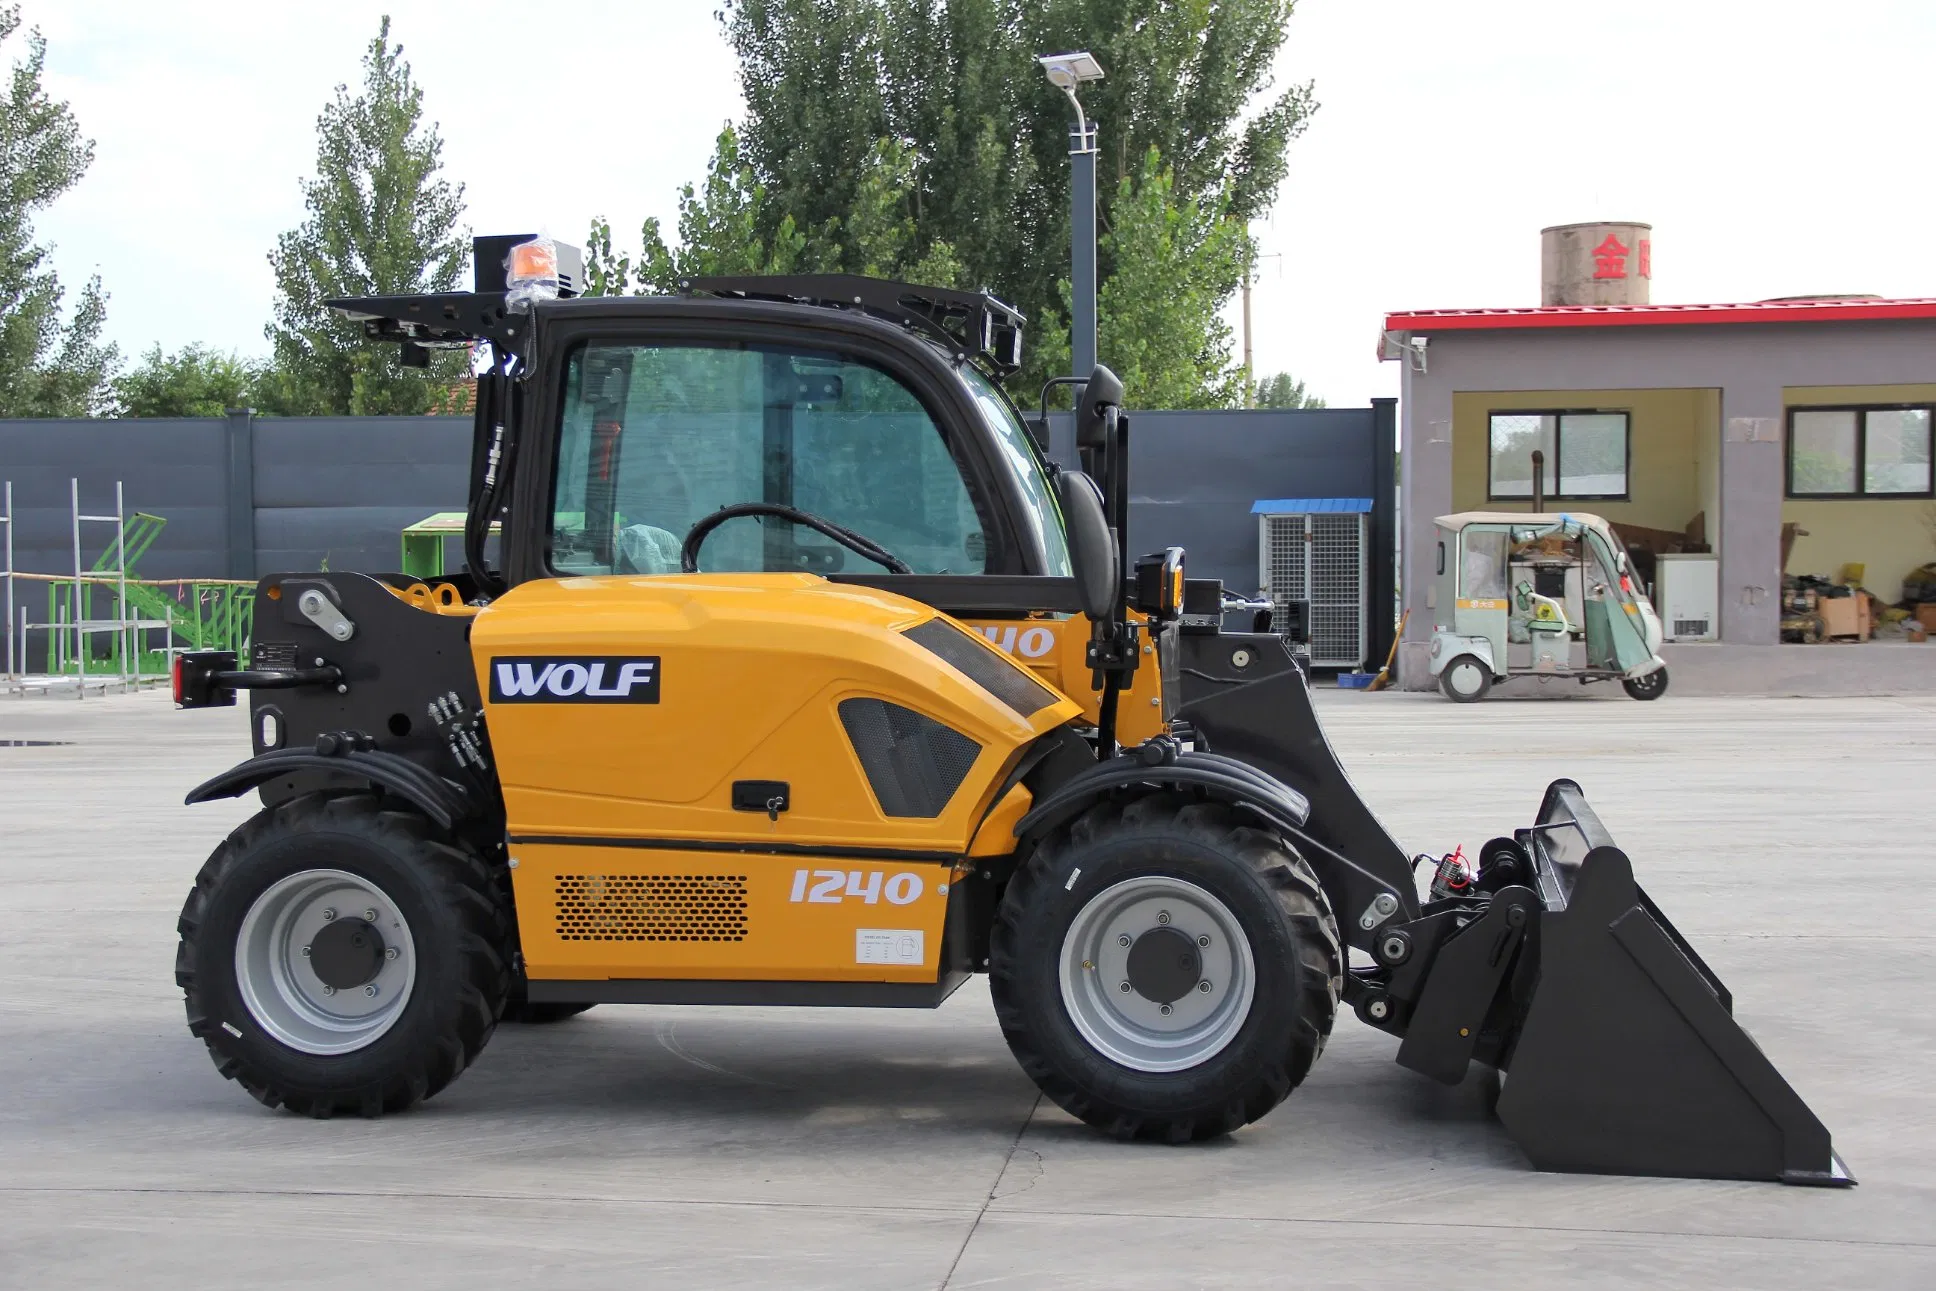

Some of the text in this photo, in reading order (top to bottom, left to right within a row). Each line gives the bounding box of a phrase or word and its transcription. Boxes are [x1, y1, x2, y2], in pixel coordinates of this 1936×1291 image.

[970, 626, 1055, 658] 40
[496, 662, 654, 697] WOLF
[789, 869, 924, 905] 1240
